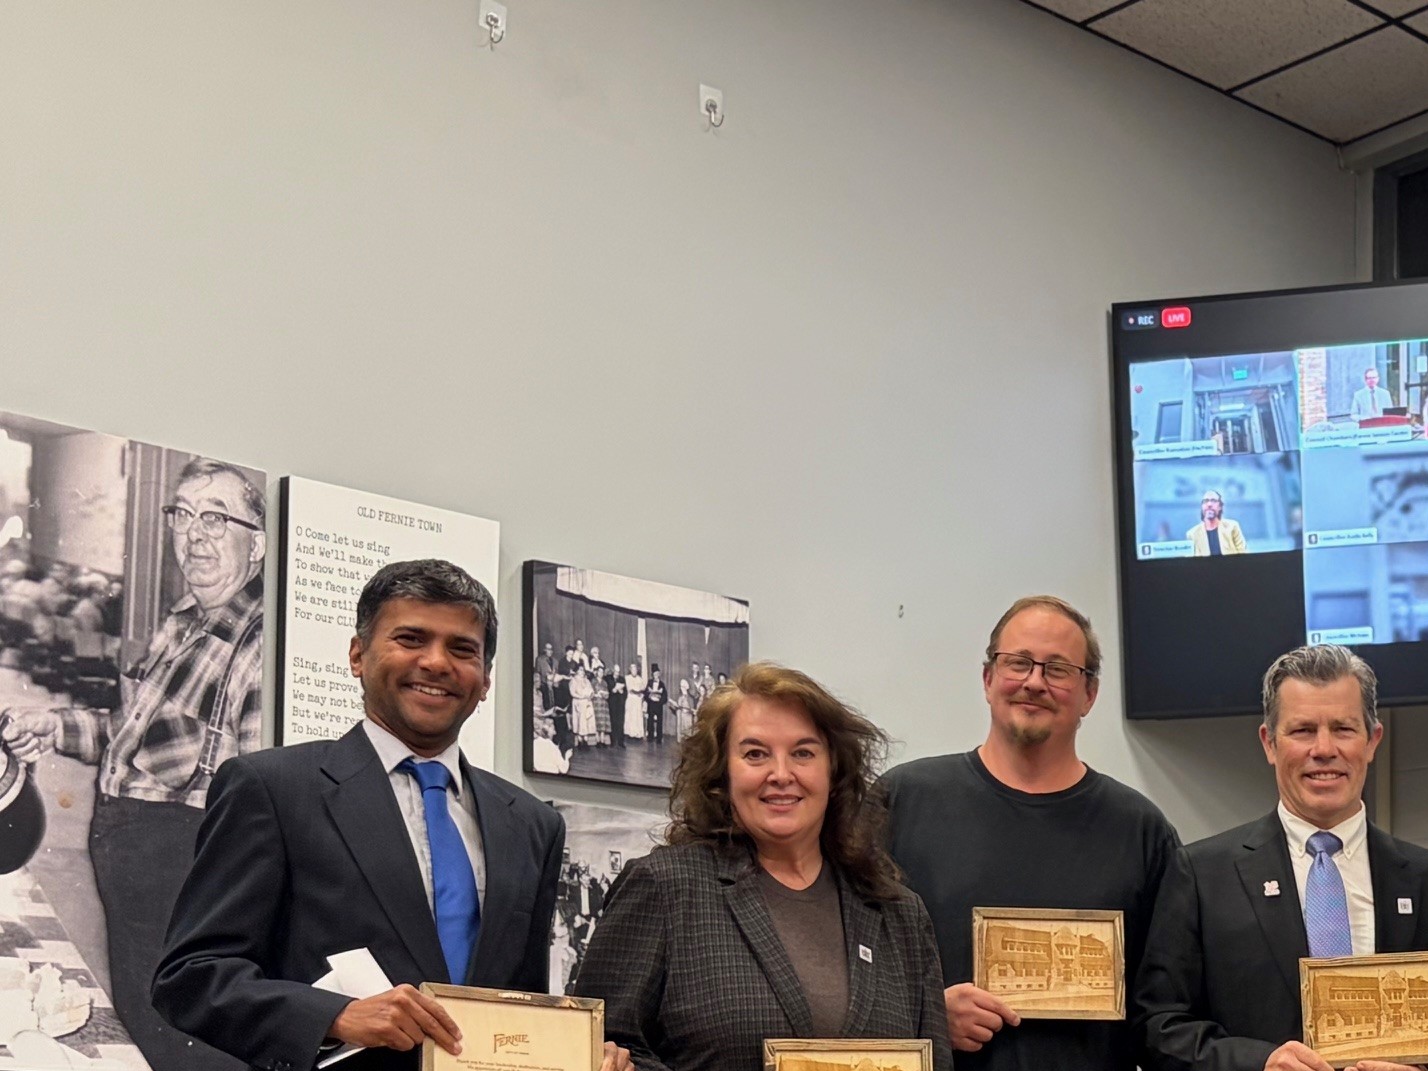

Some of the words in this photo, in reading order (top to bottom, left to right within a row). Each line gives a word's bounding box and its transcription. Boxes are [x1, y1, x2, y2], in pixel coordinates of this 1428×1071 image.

[1138, 315, 1154, 325] REC
[1168, 313, 1185, 323] LIVE
[357, 506, 376, 519] OLD
[378, 510, 415, 528] FERNIE
[417, 519, 443, 533] TOWN
[305, 527, 330, 542] Come
[333, 533, 349, 546] let
[352, 539, 364, 549] us
[367, 541, 390, 556] sing
[296, 543, 315, 555] And
[319, 546, 346, 561] We'll
[350, 554, 374, 567] make
[295, 558, 307, 570] To
[310, 561, 334, 575] show
[338, 568, 361, 580] that
[295, 575, 307, 586] As
[310, 578, 322, 589] we
[325, 581, 347, 594] face
[295, 591, 307, 603] We
[310, 596, 328, 607] are
[295, 607, 312, 620] For
[315, 613, 334, 624] our
[337, 615, 357, 627] CLU
[293, 657, 322, 673] Sing,
[325, 663, 349, 678] sing
[293, 673, 311, 686] Let
[314, 678, 326, 688] us
[329, 681, 358, 694] prove
[293, 690, 305, 701] We
[308, 695, 327, 707] may
[330, 698, 348, 709] not
[292, 706, 311, 719] But
[314, 710, 341, 724] we're
[292, 723, 304, 734] To
[306, 725, 329, 738] hold
[493, 1033, 530, 1054] FERNIE
